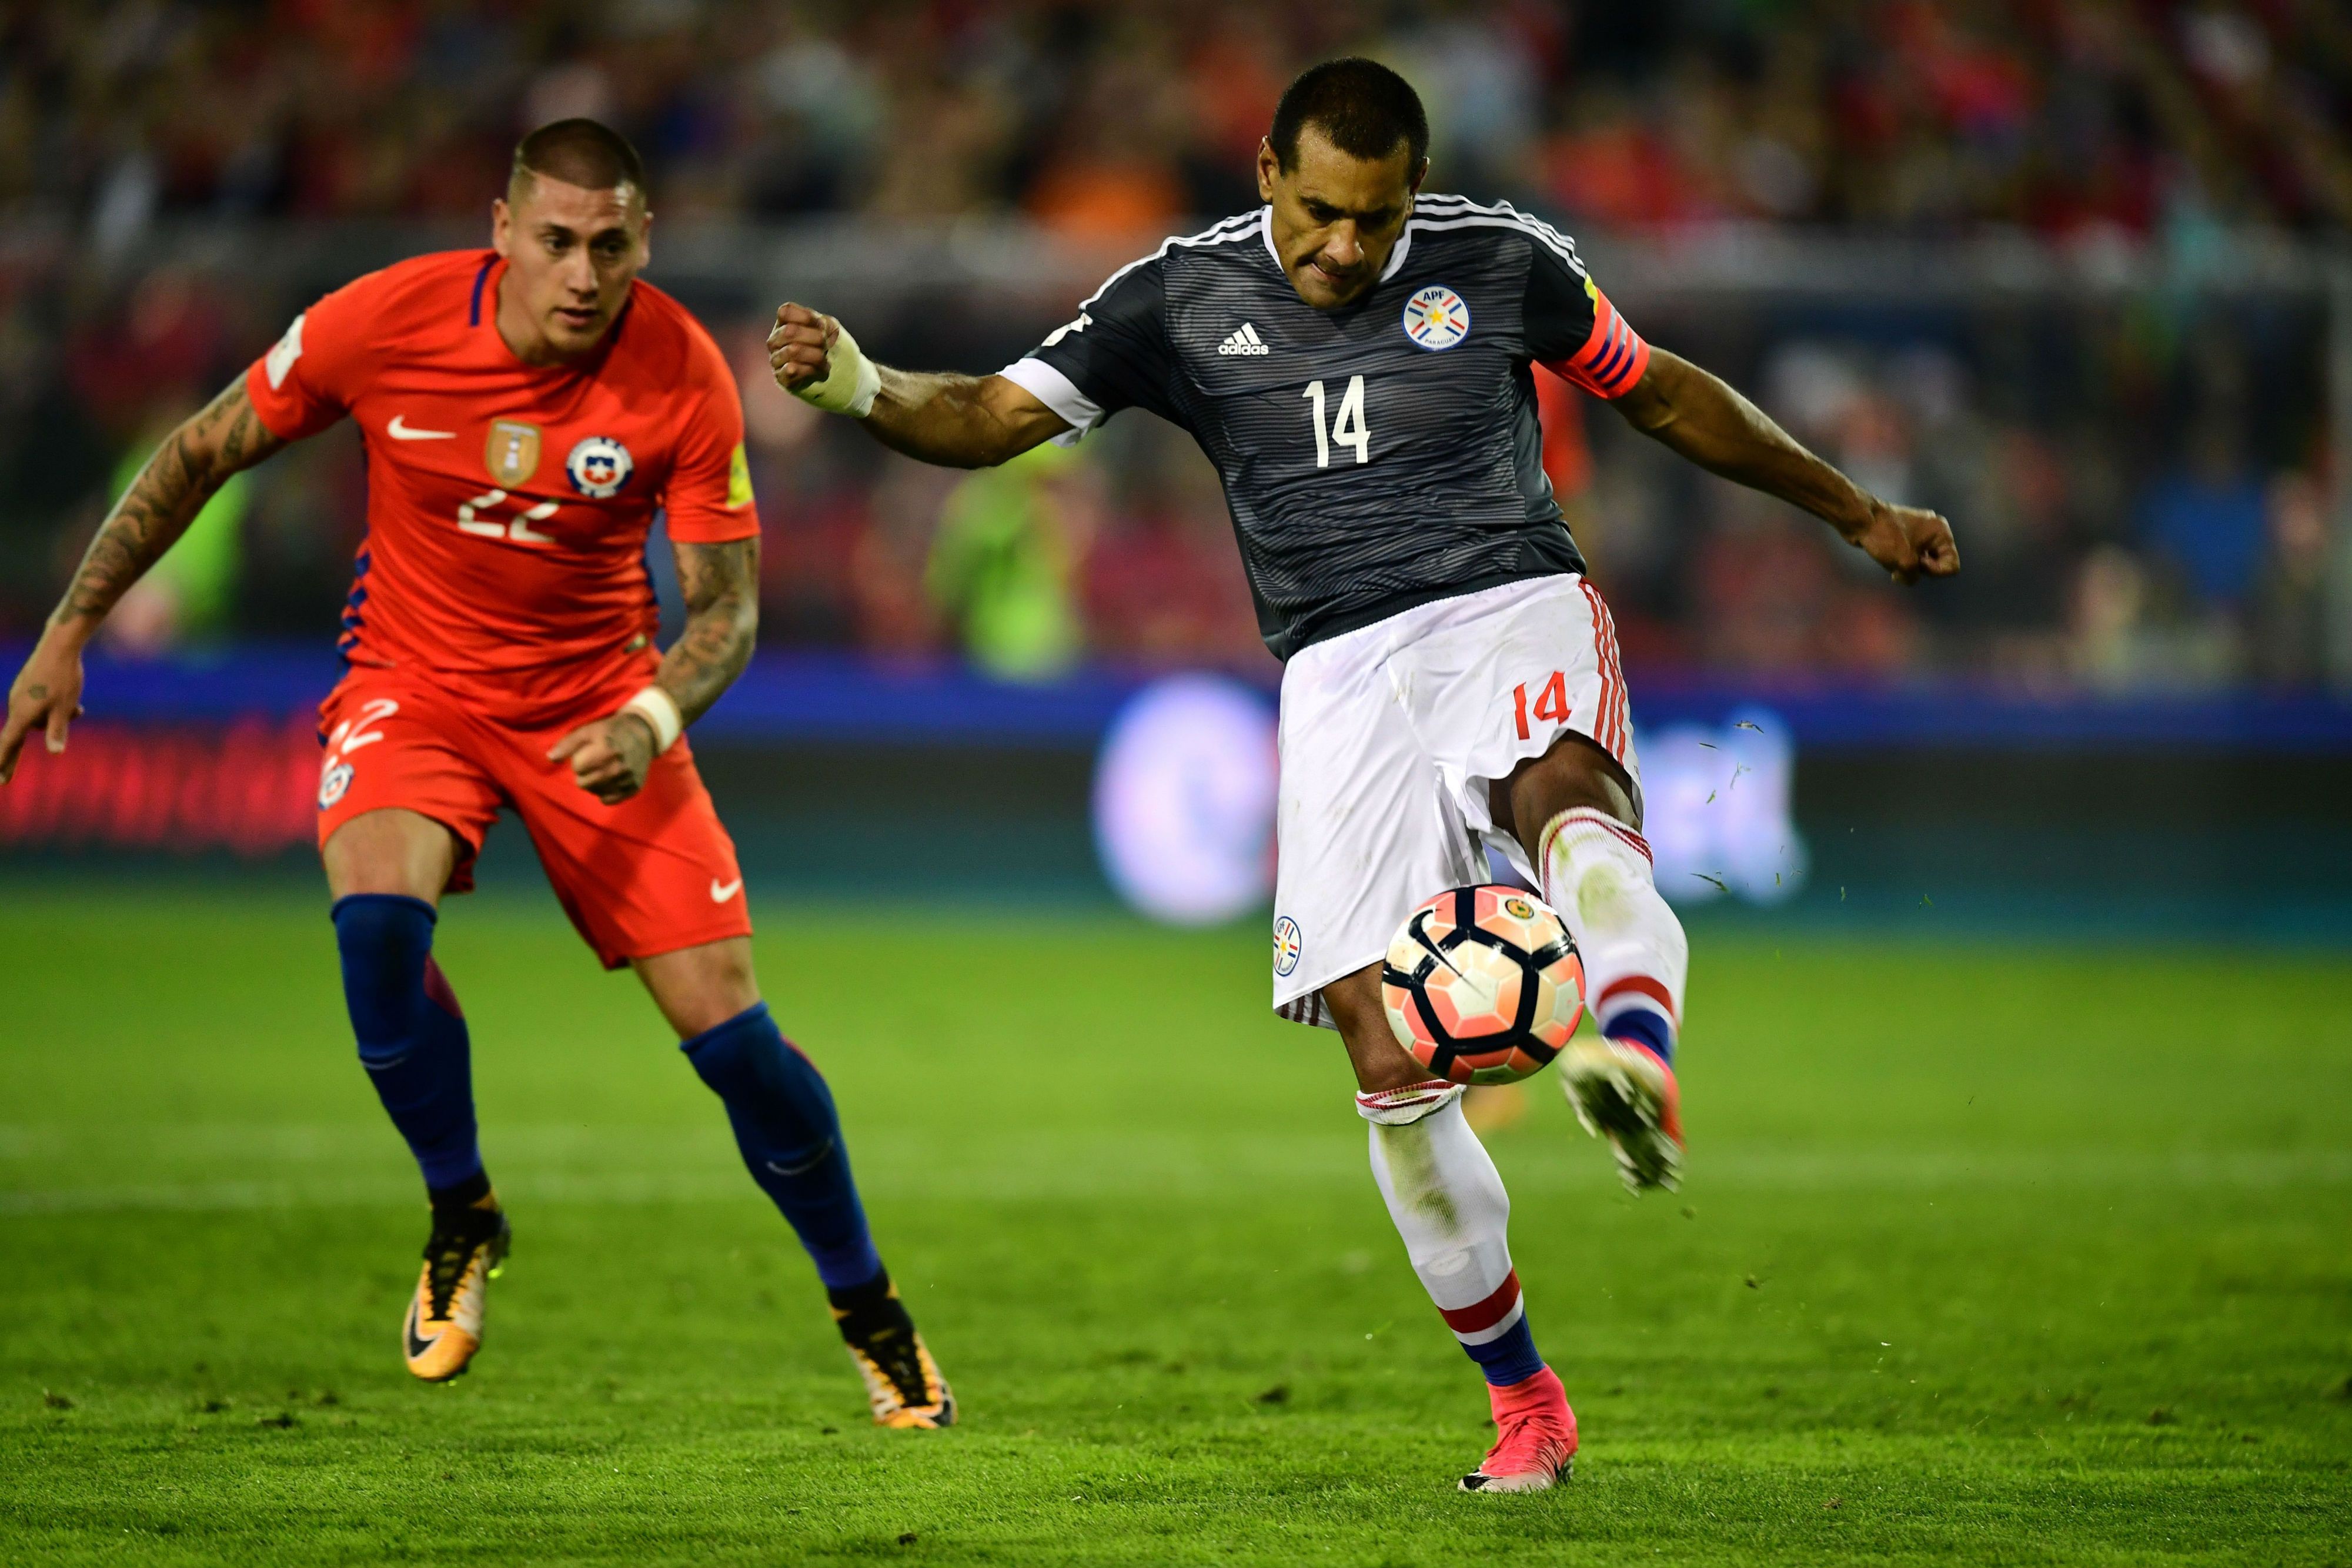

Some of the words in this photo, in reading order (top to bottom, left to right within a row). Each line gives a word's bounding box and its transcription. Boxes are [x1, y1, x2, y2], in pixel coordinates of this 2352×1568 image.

[1423, 290, 1445, 301] APF
[1218, 343, 1269, 356] adidas
[1302, 375, 1371, 468] 14
[457, 489, 560, 543] 22
[1513, 671, 1572, 740] 14
